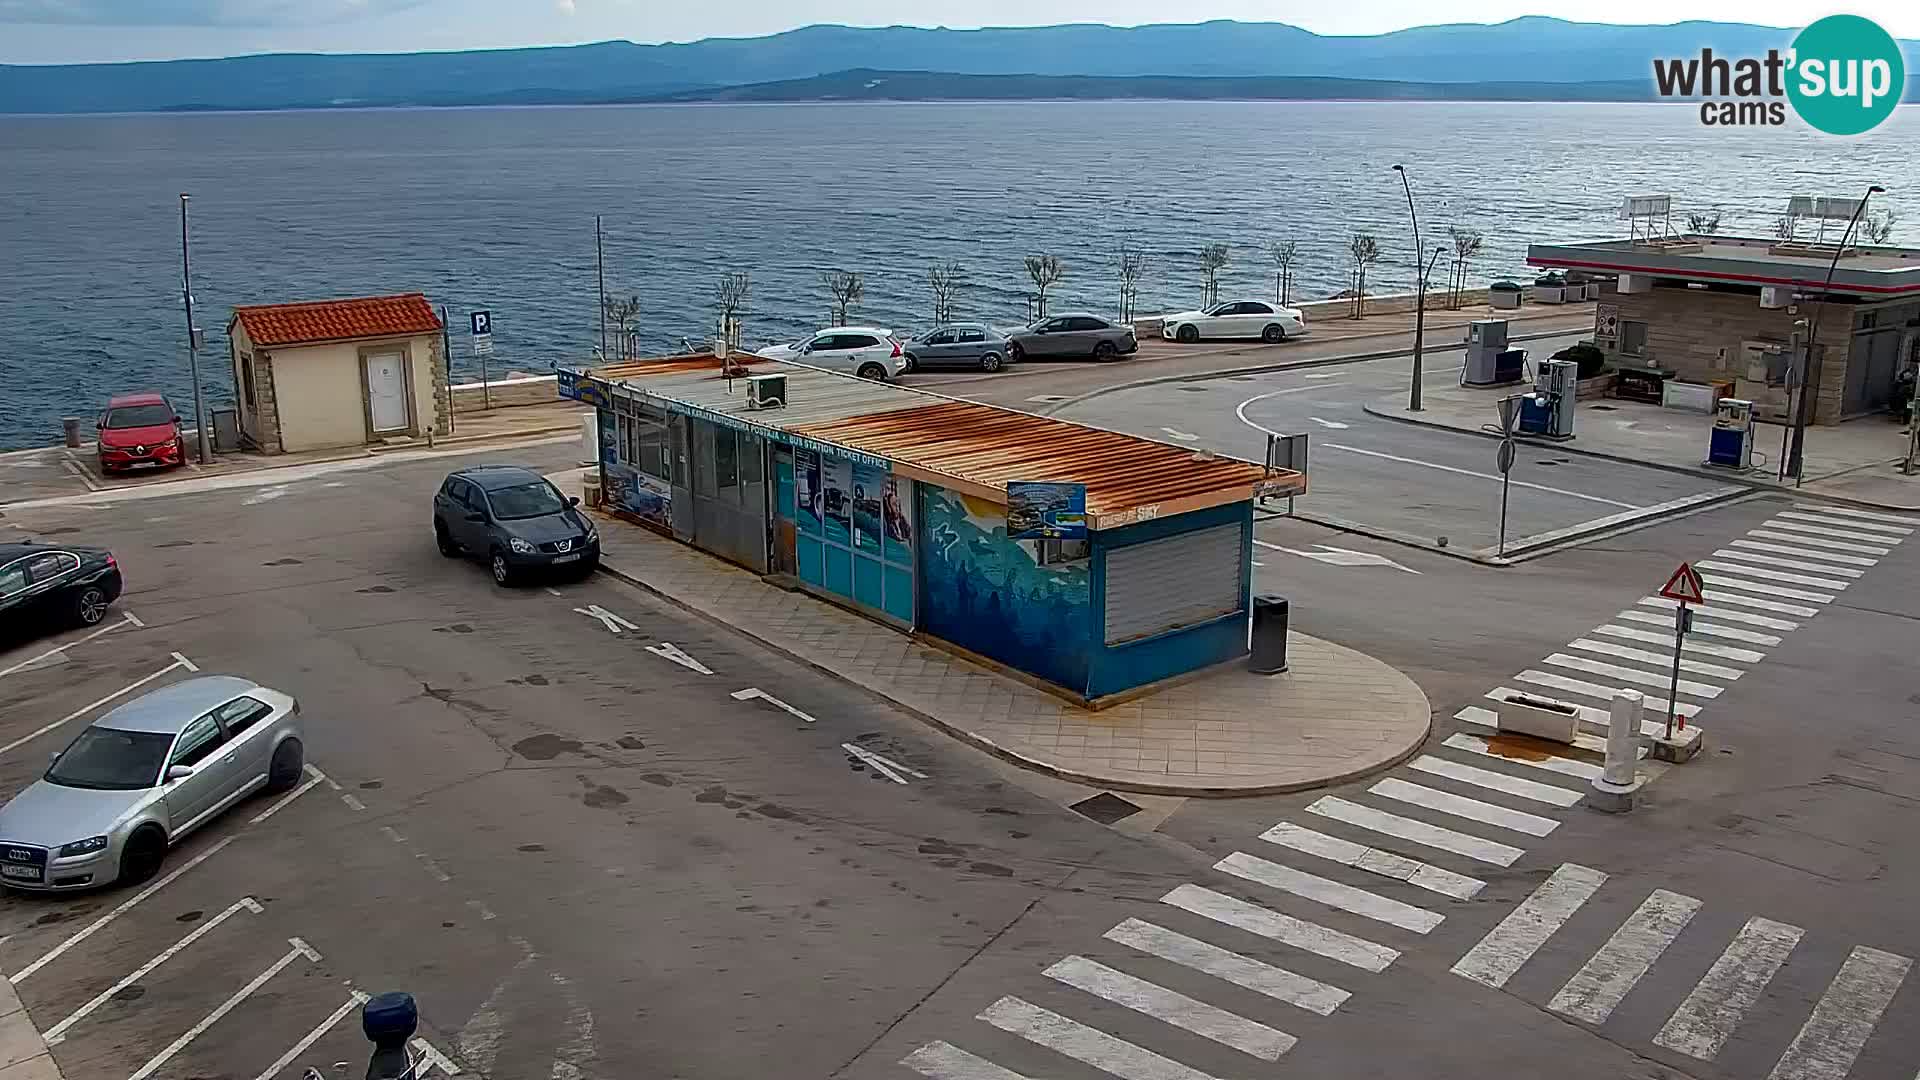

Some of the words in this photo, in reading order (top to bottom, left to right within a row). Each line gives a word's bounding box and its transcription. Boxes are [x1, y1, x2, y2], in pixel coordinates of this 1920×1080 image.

[476, 314, 487, 331] P
[750, 425, 780, 441] POSTAJA
[789, 434, 803, 447] BUS
[804, 439, 834, 455] STATION
[836, 448, 860, 463] TICKET
[862, 457, 888, 470] OFFICE
